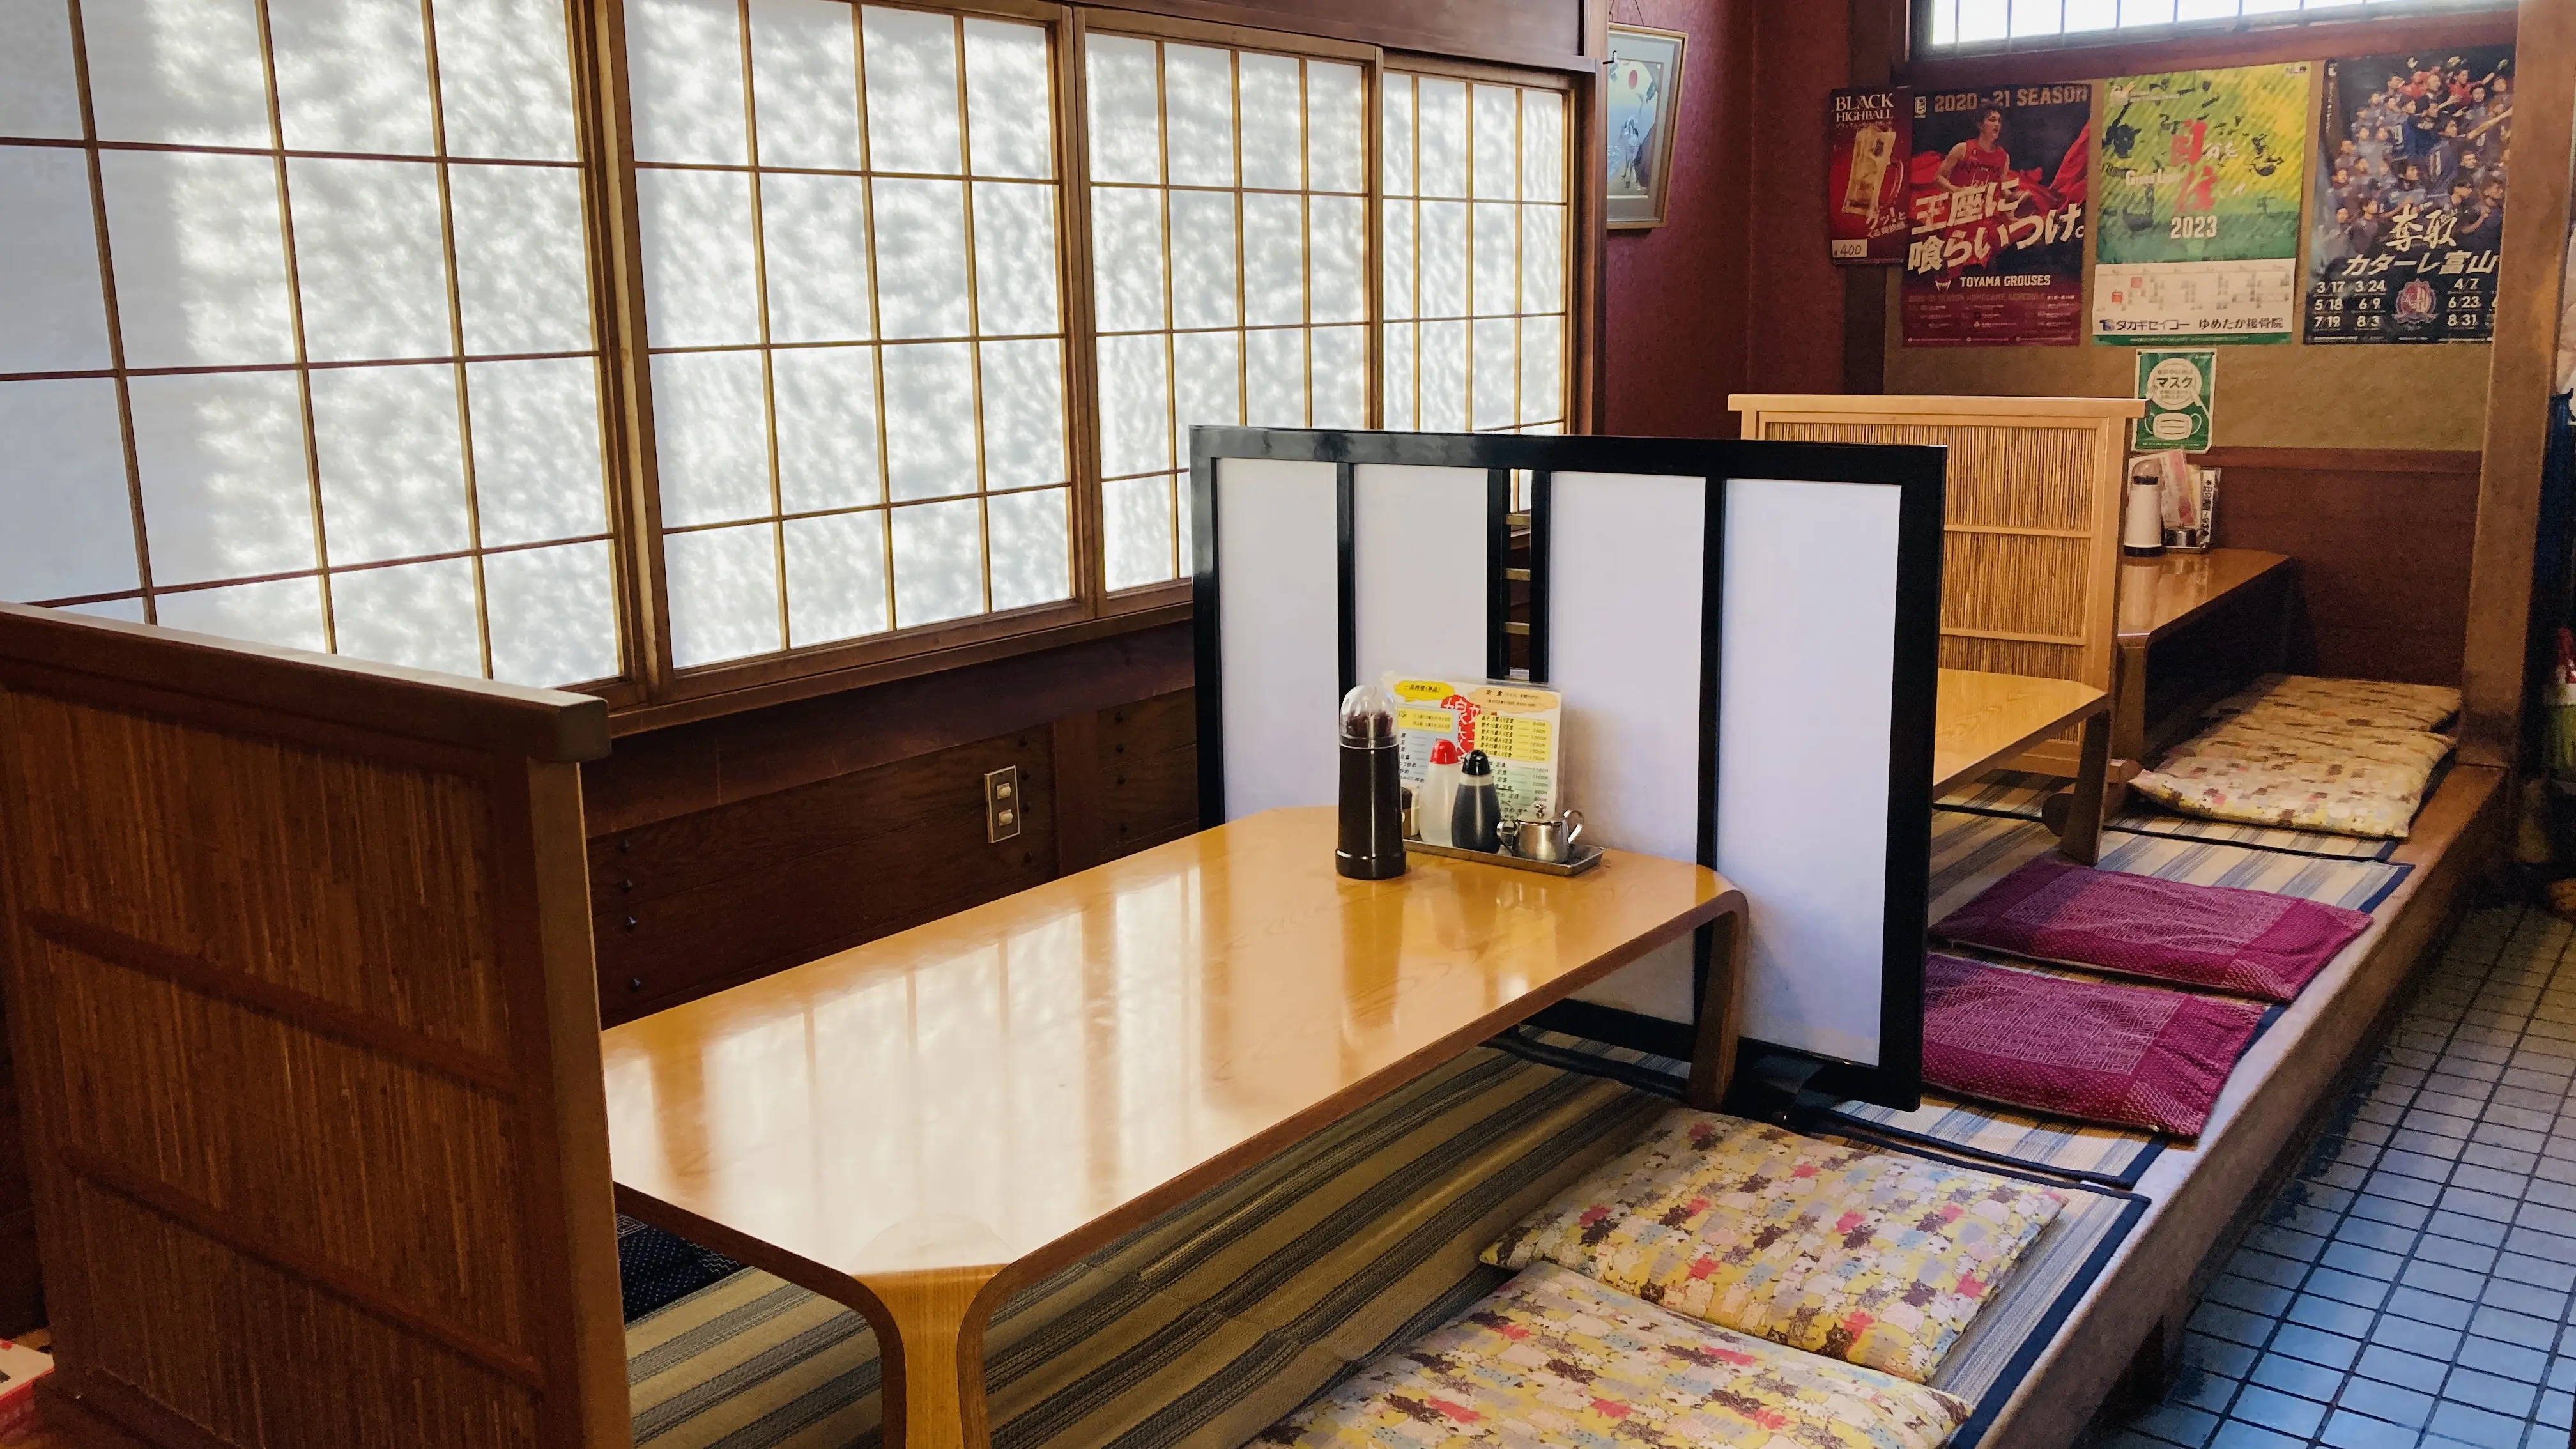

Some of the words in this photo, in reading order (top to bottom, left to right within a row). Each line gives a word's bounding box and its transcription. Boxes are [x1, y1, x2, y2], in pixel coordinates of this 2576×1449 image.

[1836, 93, 1894, 111] BLACK
[2017, 84, 2089, 107] SEASON
[1836, 109, 1893, 122] HIGHBALL
[1912, 178, 2020, 235] 王座に
[2170, 216, 2218, 239] 2023
[2342, 250, 2499, 275] カターレ富山
[1960, 275, 2001, 288] TOYAMA
[2004, 275, 2051, 287] GROUSES
[2317, 281, 2345, 293] 3/17
[2355, 280, 2386, 293] 3/24
[2453, 278, 2480, 291] 4/7
[2314, 298, 2343, 310] 5/18
[2359, 298, 2381, 310] 6/9
[2448, 296, 2480, 309] 6/23
[2115, 319, 2190, 330] タカギセイコー
[2199, 318, 2283, 329] ゆめたか接骨院
[2314, 316, 2341, 328] 7/19
[2357, 315, 2380, 327] 8/3
[2448, 314, 2478, 326] 8/31
[2156, 376, 2193, 388] マスク
